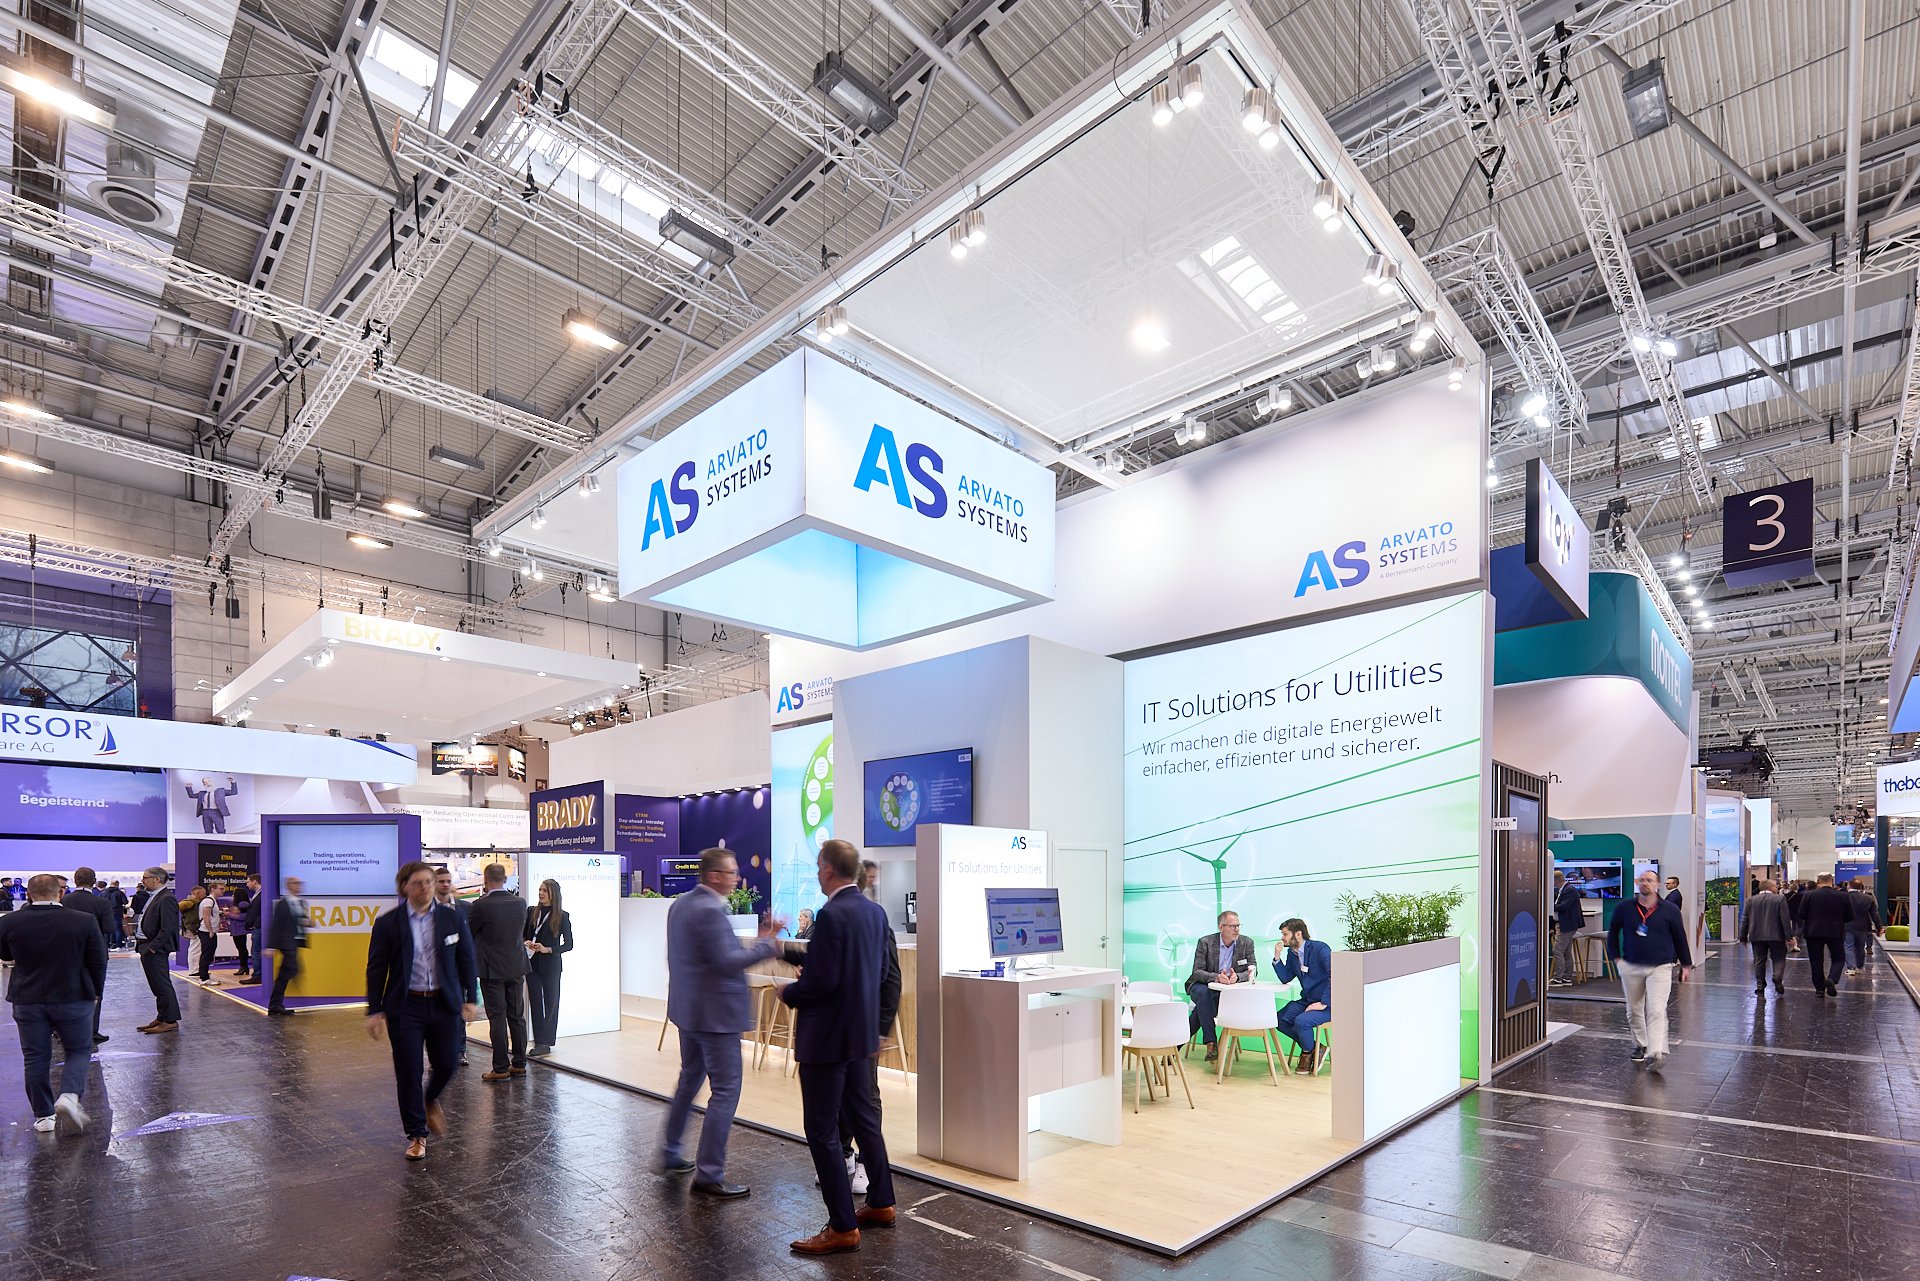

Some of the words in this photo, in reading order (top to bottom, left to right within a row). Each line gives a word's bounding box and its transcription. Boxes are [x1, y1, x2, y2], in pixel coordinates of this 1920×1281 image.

[707, 428, 768, 481] ARVATO
[706, 453, 773, 507] SYSTEMS
[853, 423, 948, 519] AS
[641, 460, 700, 553] AS
[958, 475, 1025, 518] ARVATO
[957, 501, 1029, 544] SYSTEMS
[1748, 494, 1786, 552] 3
[1380, 521, 1453, 551] ARVATO
[1379, 538, 1457, 568] SYSTEMS
[1293, 540, 1371, 599] AS
[1385, 564, 1426, 579] Bertelsmann
[1426, 557, 1458, 569] Company
[806, 687, 834, 701] SYSTEMS
[807, 677, 833, 690] ARVATO
[1143, 701, 1161, 724] IT
[1168, 686, 1276, 721] Solutions
[1286, 678, 1323, 704] for
[1334, 661, 1443, 697] Utilities
[776, 682, 804, 713] AS
[1143, 740, 1164, 756] Wir
[1170, 731, 1229, 753] machen
[1234, 729, 1258, 745] die
[1262, 720, 1324, 745] digitale
[1330, 705, 1442, 734] Energiewelt
[30, 741, 55, 754] AG
[1143, 757, 1211, 777] einfacher,
[1215, 749, 1295, 769] effizienter
[1301, 742, 1335, 761] und
[1341, 735, 1421, 758] sicherer.
[20, 794, 109, 808] Begeisternd.
[433, 810, 461, 818] Reducing
[537, 794, 596, 831] BRADY.
[536, 838, 554, 847] Powering
[554, 837, 573, 846] efficiency
[573, 836, 581, 844] and
[580, 835, 596, 845] change
[1011, 836, 1027, 850] AS
[205, 861, 229, 869] Day-ahead
[230, 862, 249, 870] Intraday
[206, 870, 232, 878] Algorithmic
[231, 870, 248, 878] Trading
[350, 859, 380, 867] scheduling
[587, 858, 601, 867] AS
[948, 861, 956, 873] IT
[958, 861, 998, 874] Solutions
[1000, 862, 1012, 874] for
[1013, 862, 1043, 875] Utilities
[577, 873, 588, 881] for
[306, 905, 381, 928] RADY
